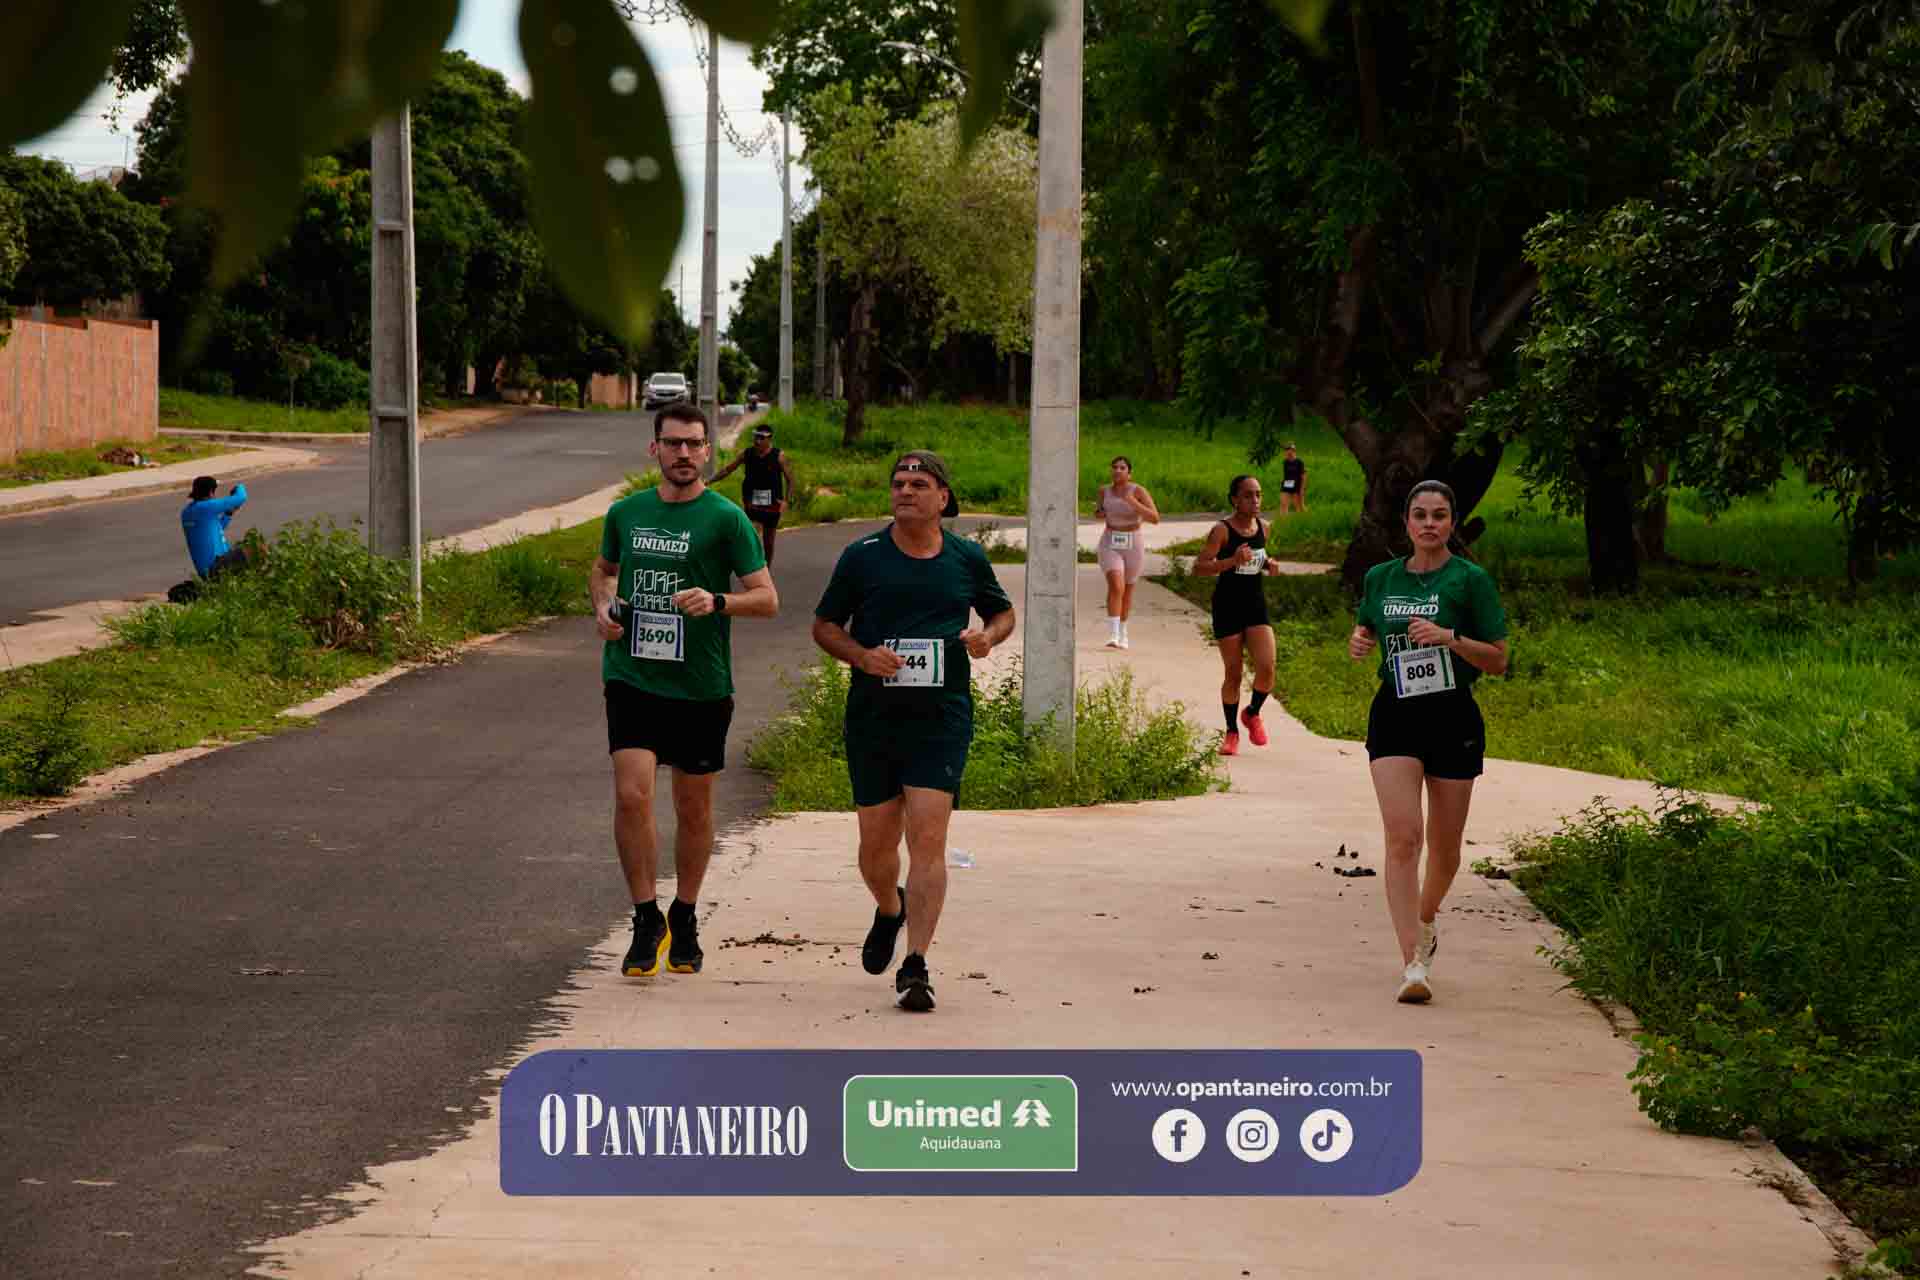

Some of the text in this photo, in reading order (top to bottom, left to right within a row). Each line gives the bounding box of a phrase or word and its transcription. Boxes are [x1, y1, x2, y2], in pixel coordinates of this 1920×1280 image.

[632, 536, 689, 554] UNIMED
[1384, 604, 1439, 616] UNIMED
[638, 627, 676, 645] 3690
[899, 656, 927, 669] 44
[1407, 663, 1436, 680] 808
